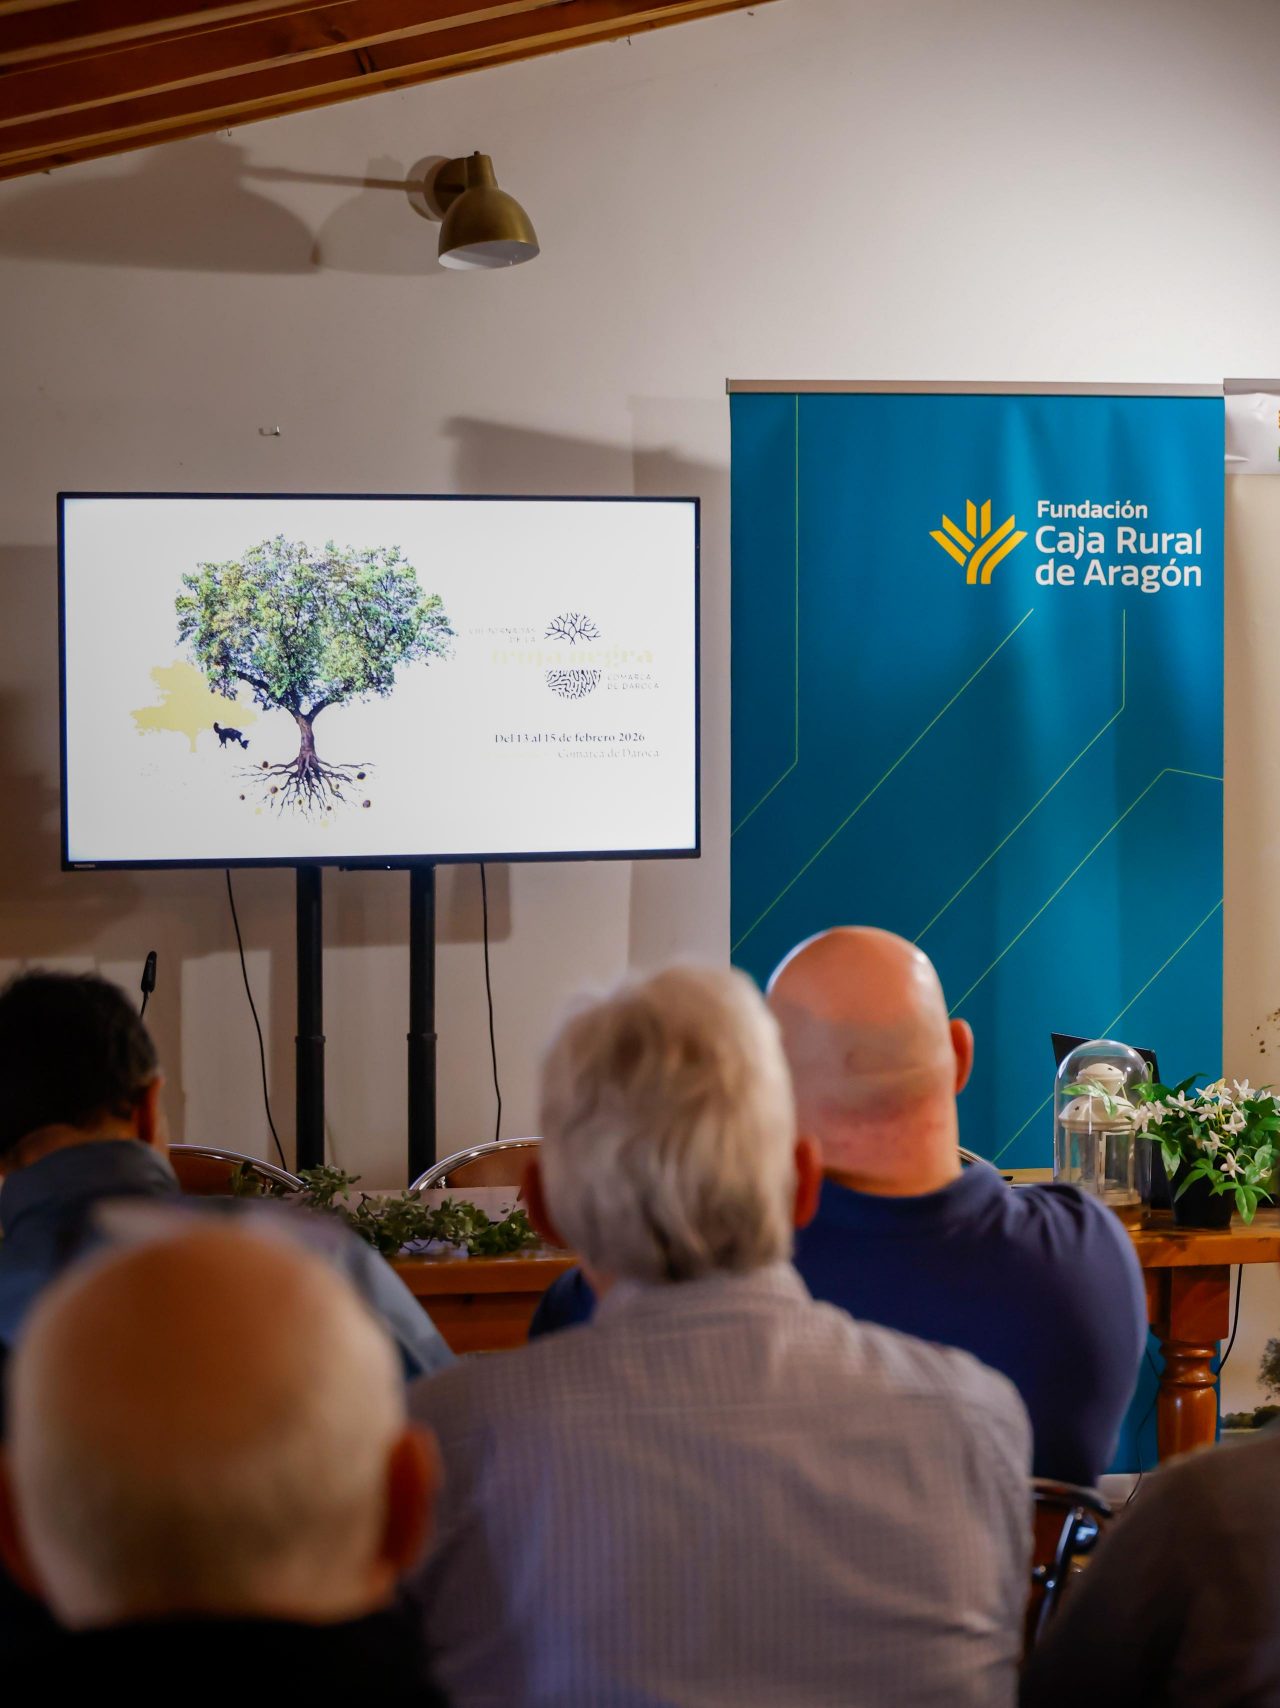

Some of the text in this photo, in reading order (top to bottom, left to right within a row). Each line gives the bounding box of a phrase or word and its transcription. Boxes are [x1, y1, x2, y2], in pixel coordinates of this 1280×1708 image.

[1037, 500, 1148, 519] Fundación
[1035, 525, 1202, 560] Caja Rural
[1035, 558, 1202, 593] de Aragón
[495, 732, 645, 743] Del 13 al 15 de febrero 2026
[558, 748, 605, 758] Comarca
[607, 748, 619, 758] de
[622, 747, 660, 758] Daroca
